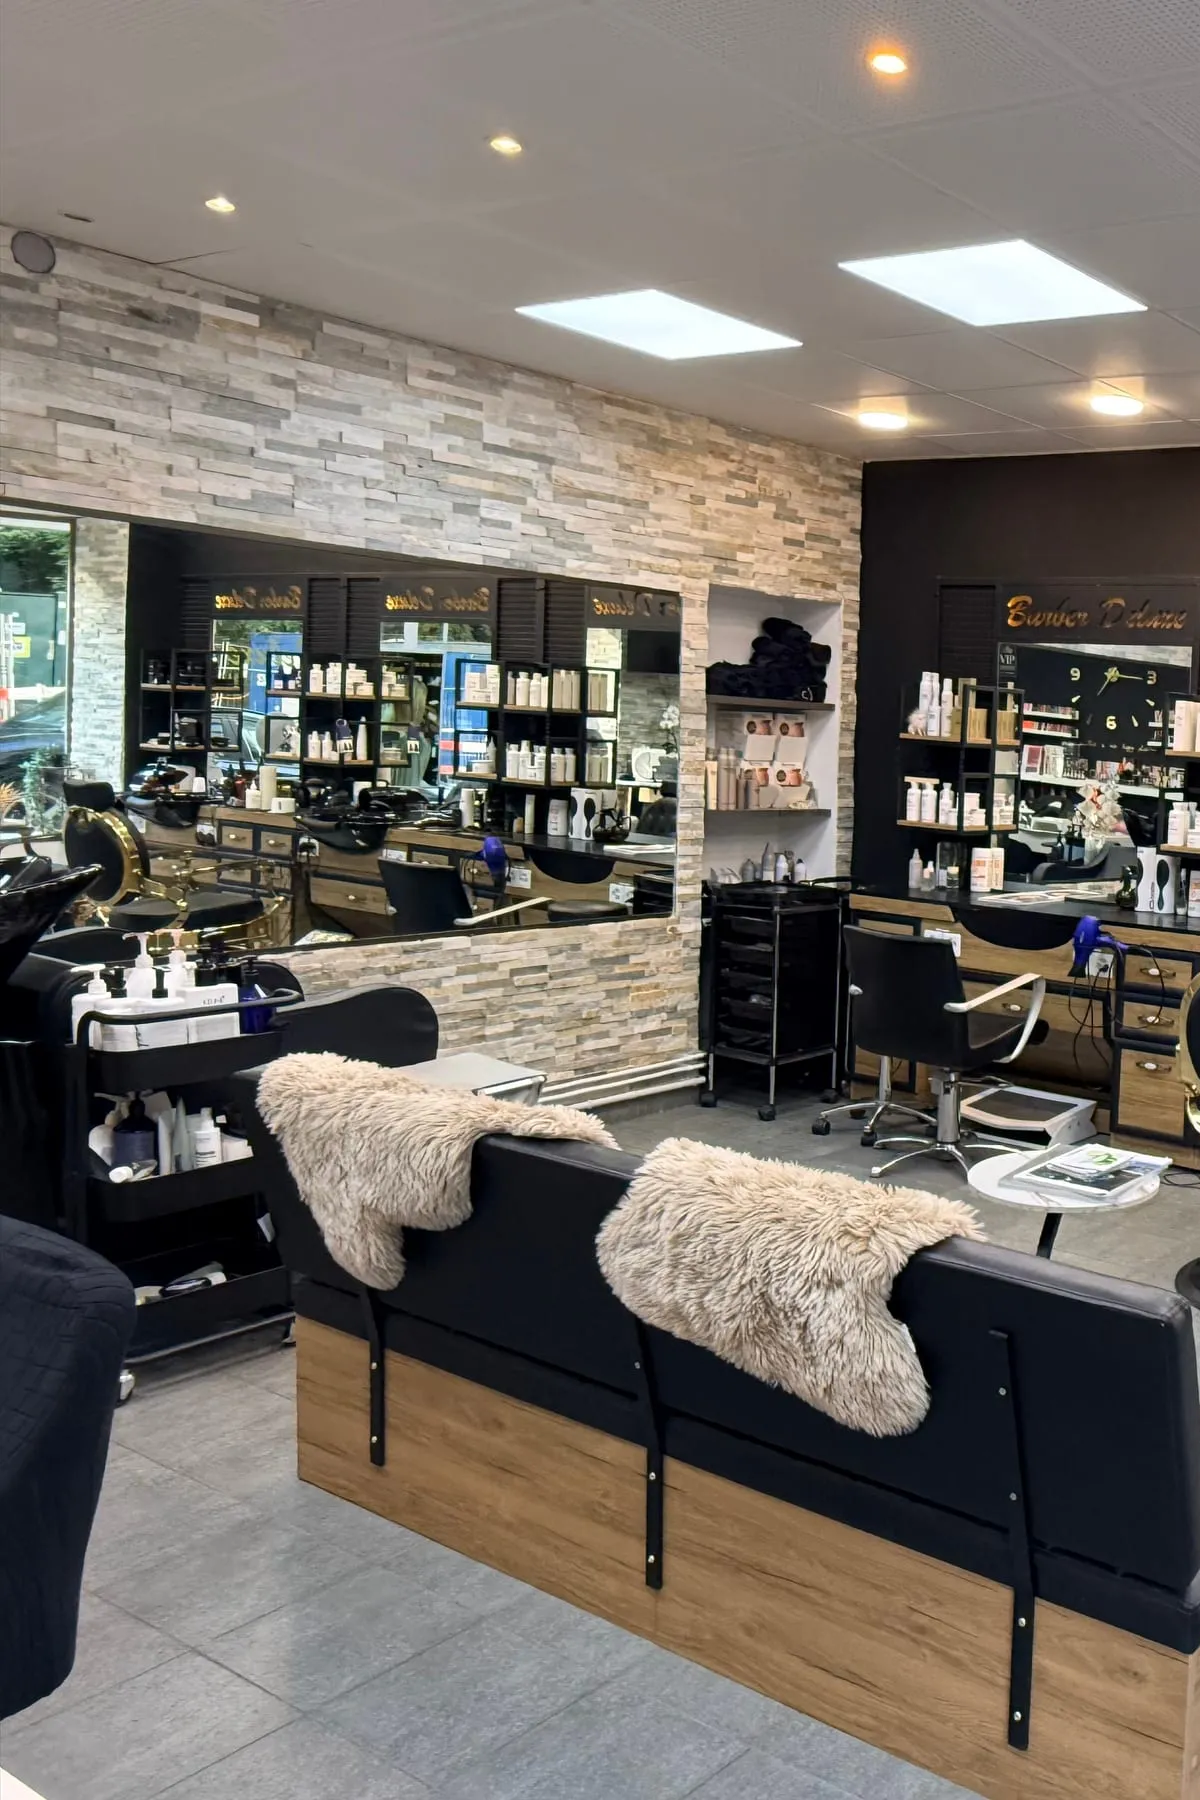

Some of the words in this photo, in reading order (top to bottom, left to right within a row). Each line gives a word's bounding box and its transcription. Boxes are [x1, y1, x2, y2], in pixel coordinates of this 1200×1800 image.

[1007, 594, 1090, 628] Barber
[1070, 668, 1081, 681] 9
[1147, 671, 1157, 685] 3
[1106, 715, 1117, 730] 6
